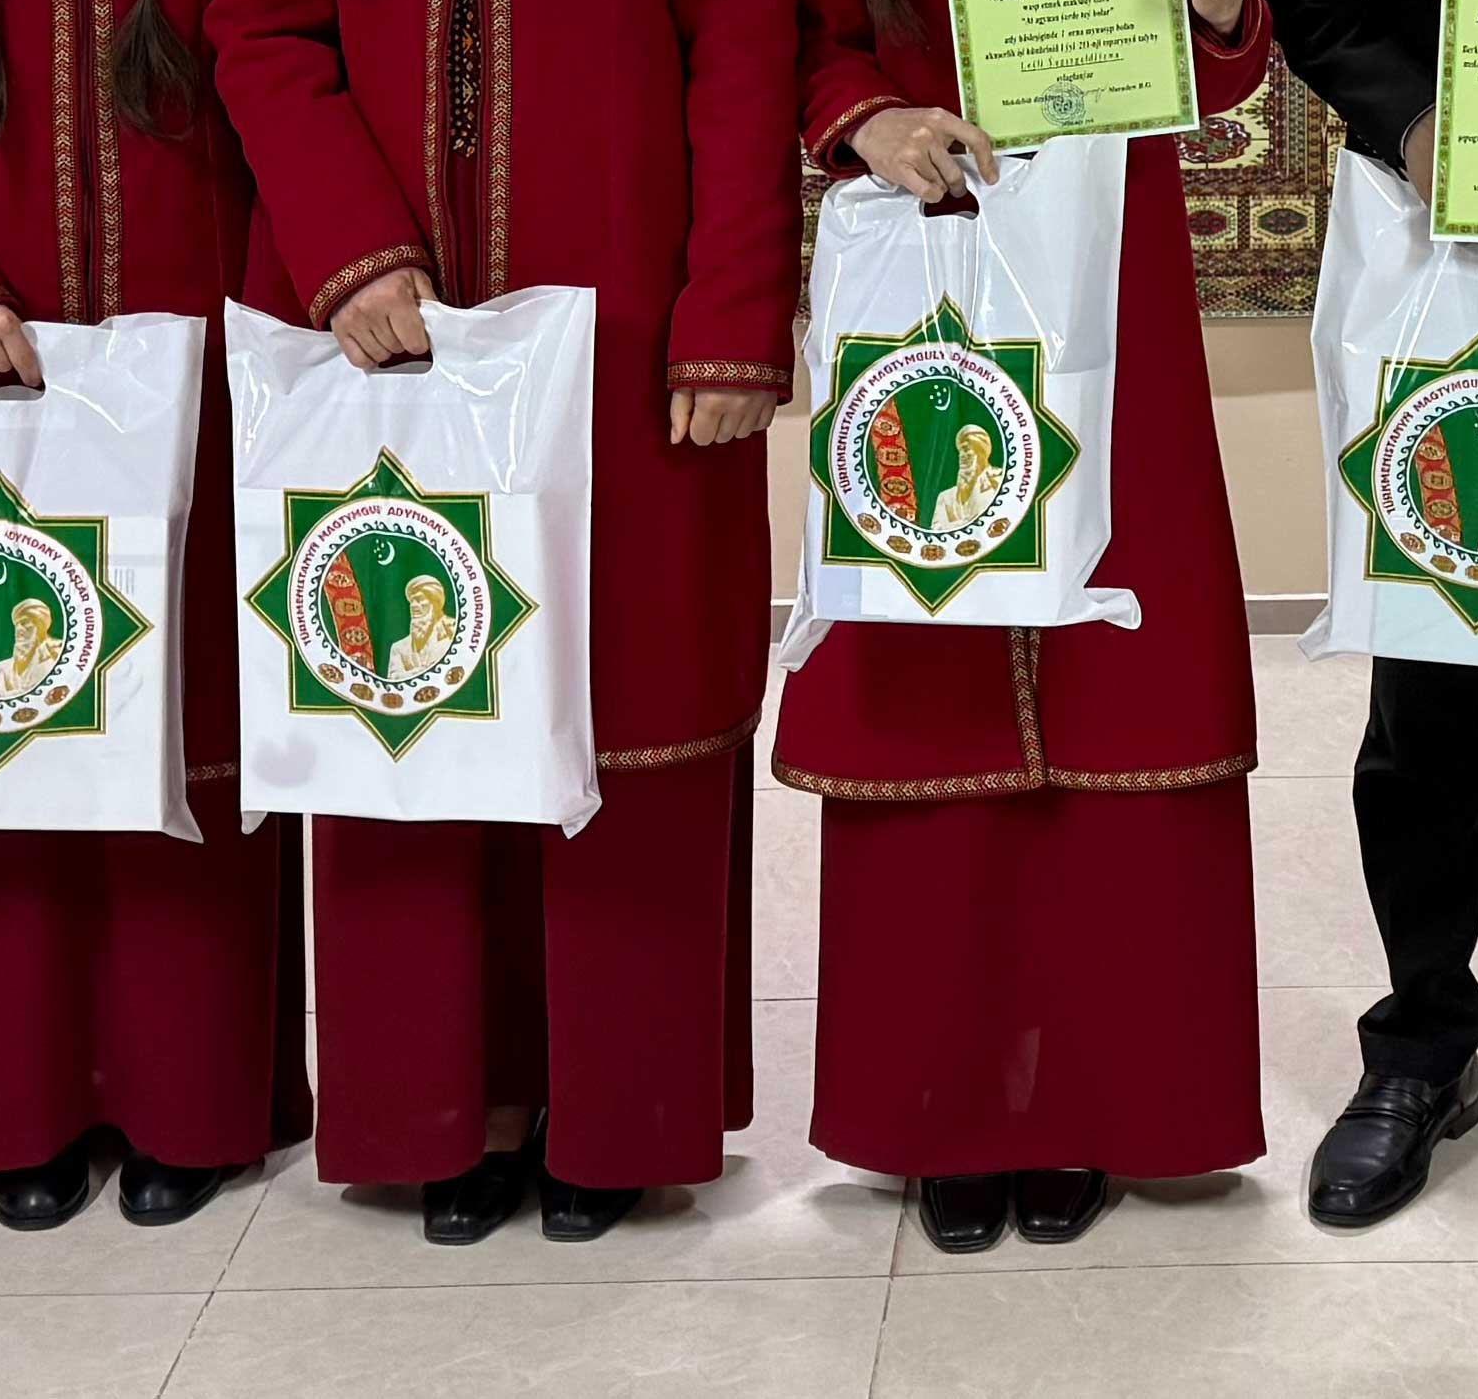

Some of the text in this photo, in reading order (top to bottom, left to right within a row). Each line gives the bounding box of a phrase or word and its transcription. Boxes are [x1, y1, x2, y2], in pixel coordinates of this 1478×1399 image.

[867, 351, 945, 386] MAGTYMGULY
[1014, 433, 1031, 502] GURAMASY
[75, 607, 94, 672] GURAMASY
[467, 585, 483, 653] GURAMASY
